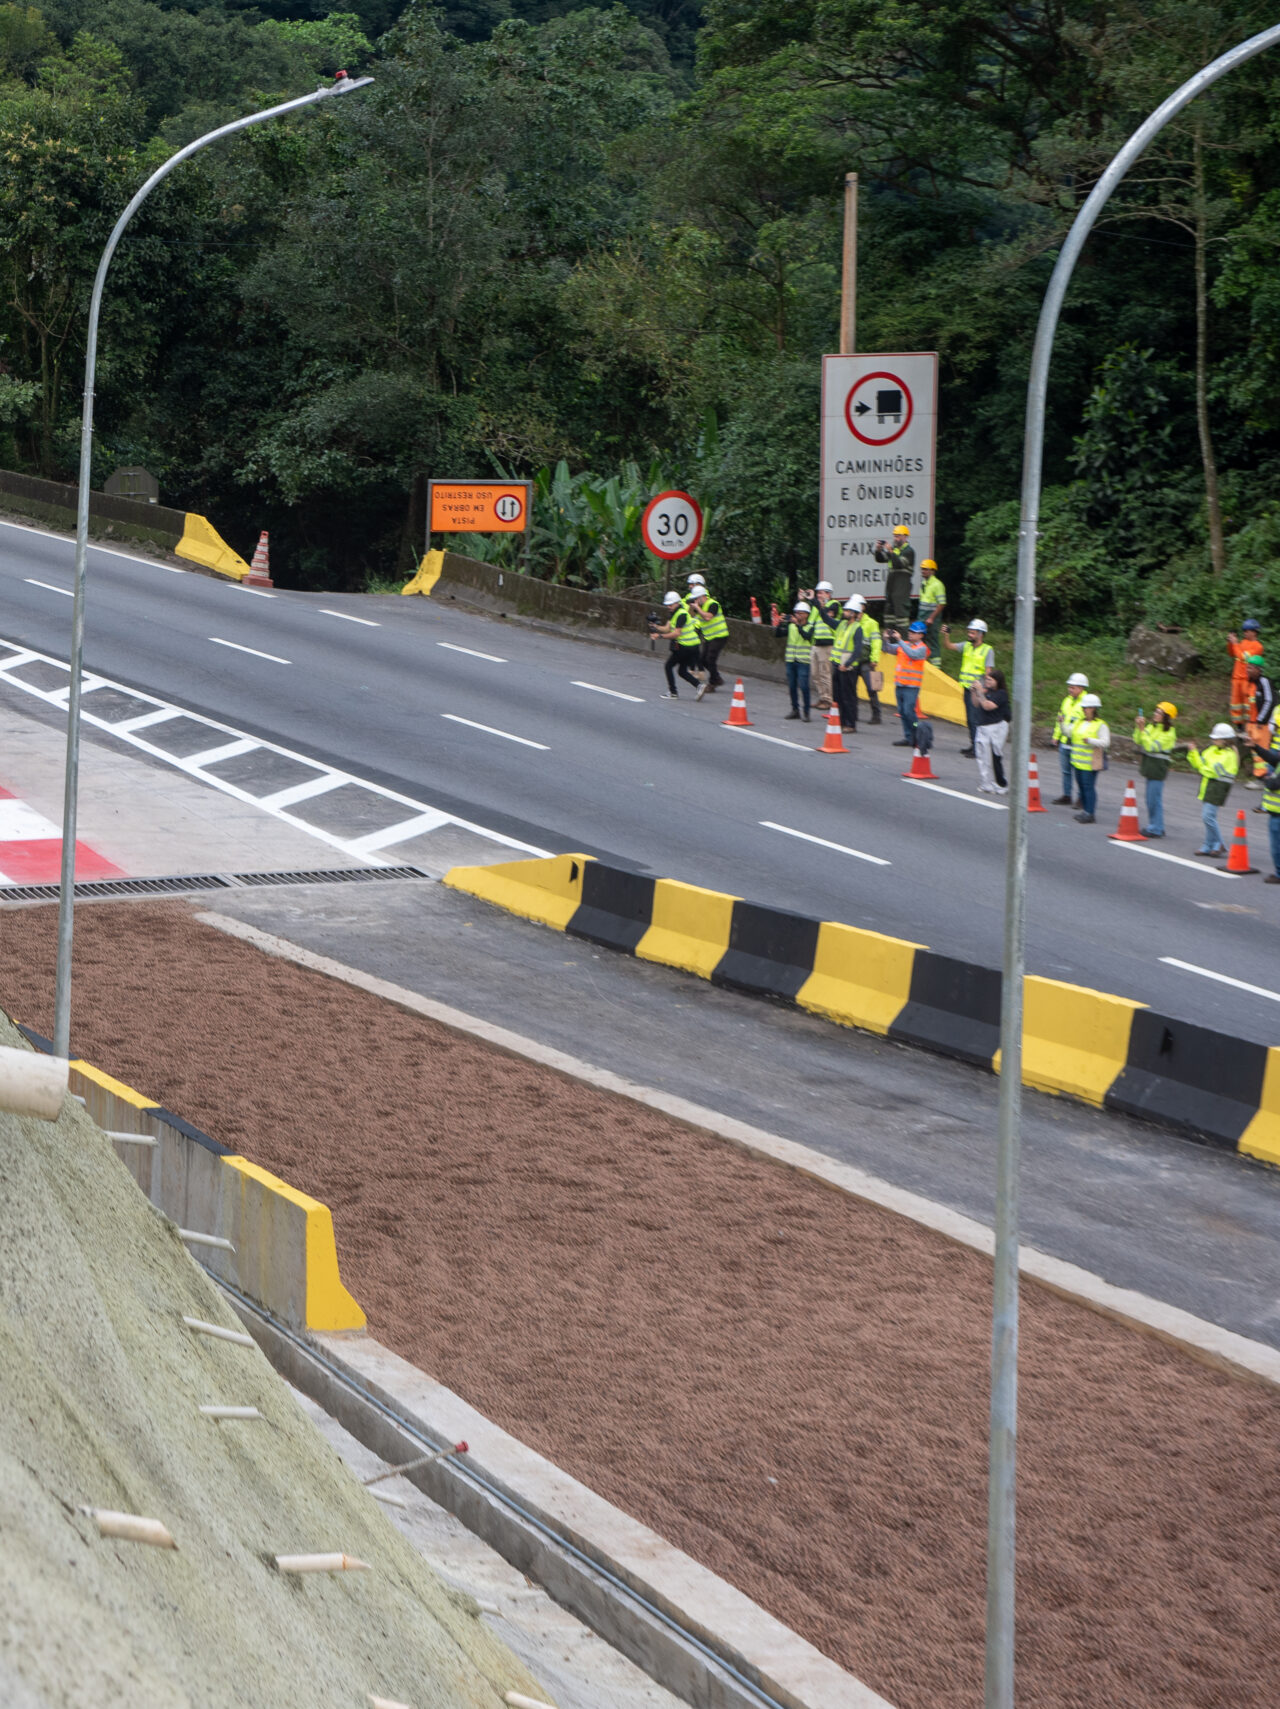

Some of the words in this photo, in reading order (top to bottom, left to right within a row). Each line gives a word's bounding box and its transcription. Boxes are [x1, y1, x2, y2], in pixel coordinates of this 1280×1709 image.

[835, 455, 923, 474] CAMINHÕES
[435, 491, 473, 499] RESTRITO
[476, 491, 492, 499] USO
[841, 487, 850, 501] E
[857, 484, 914, 500] ÔNIBUS
[657, 513, 689, 537] 30
[827, 507, 928, 529] OBRIGATÓRIO
[840, 542, 875, 556] FAIX
[847, 569, 887, 583] DIREI
